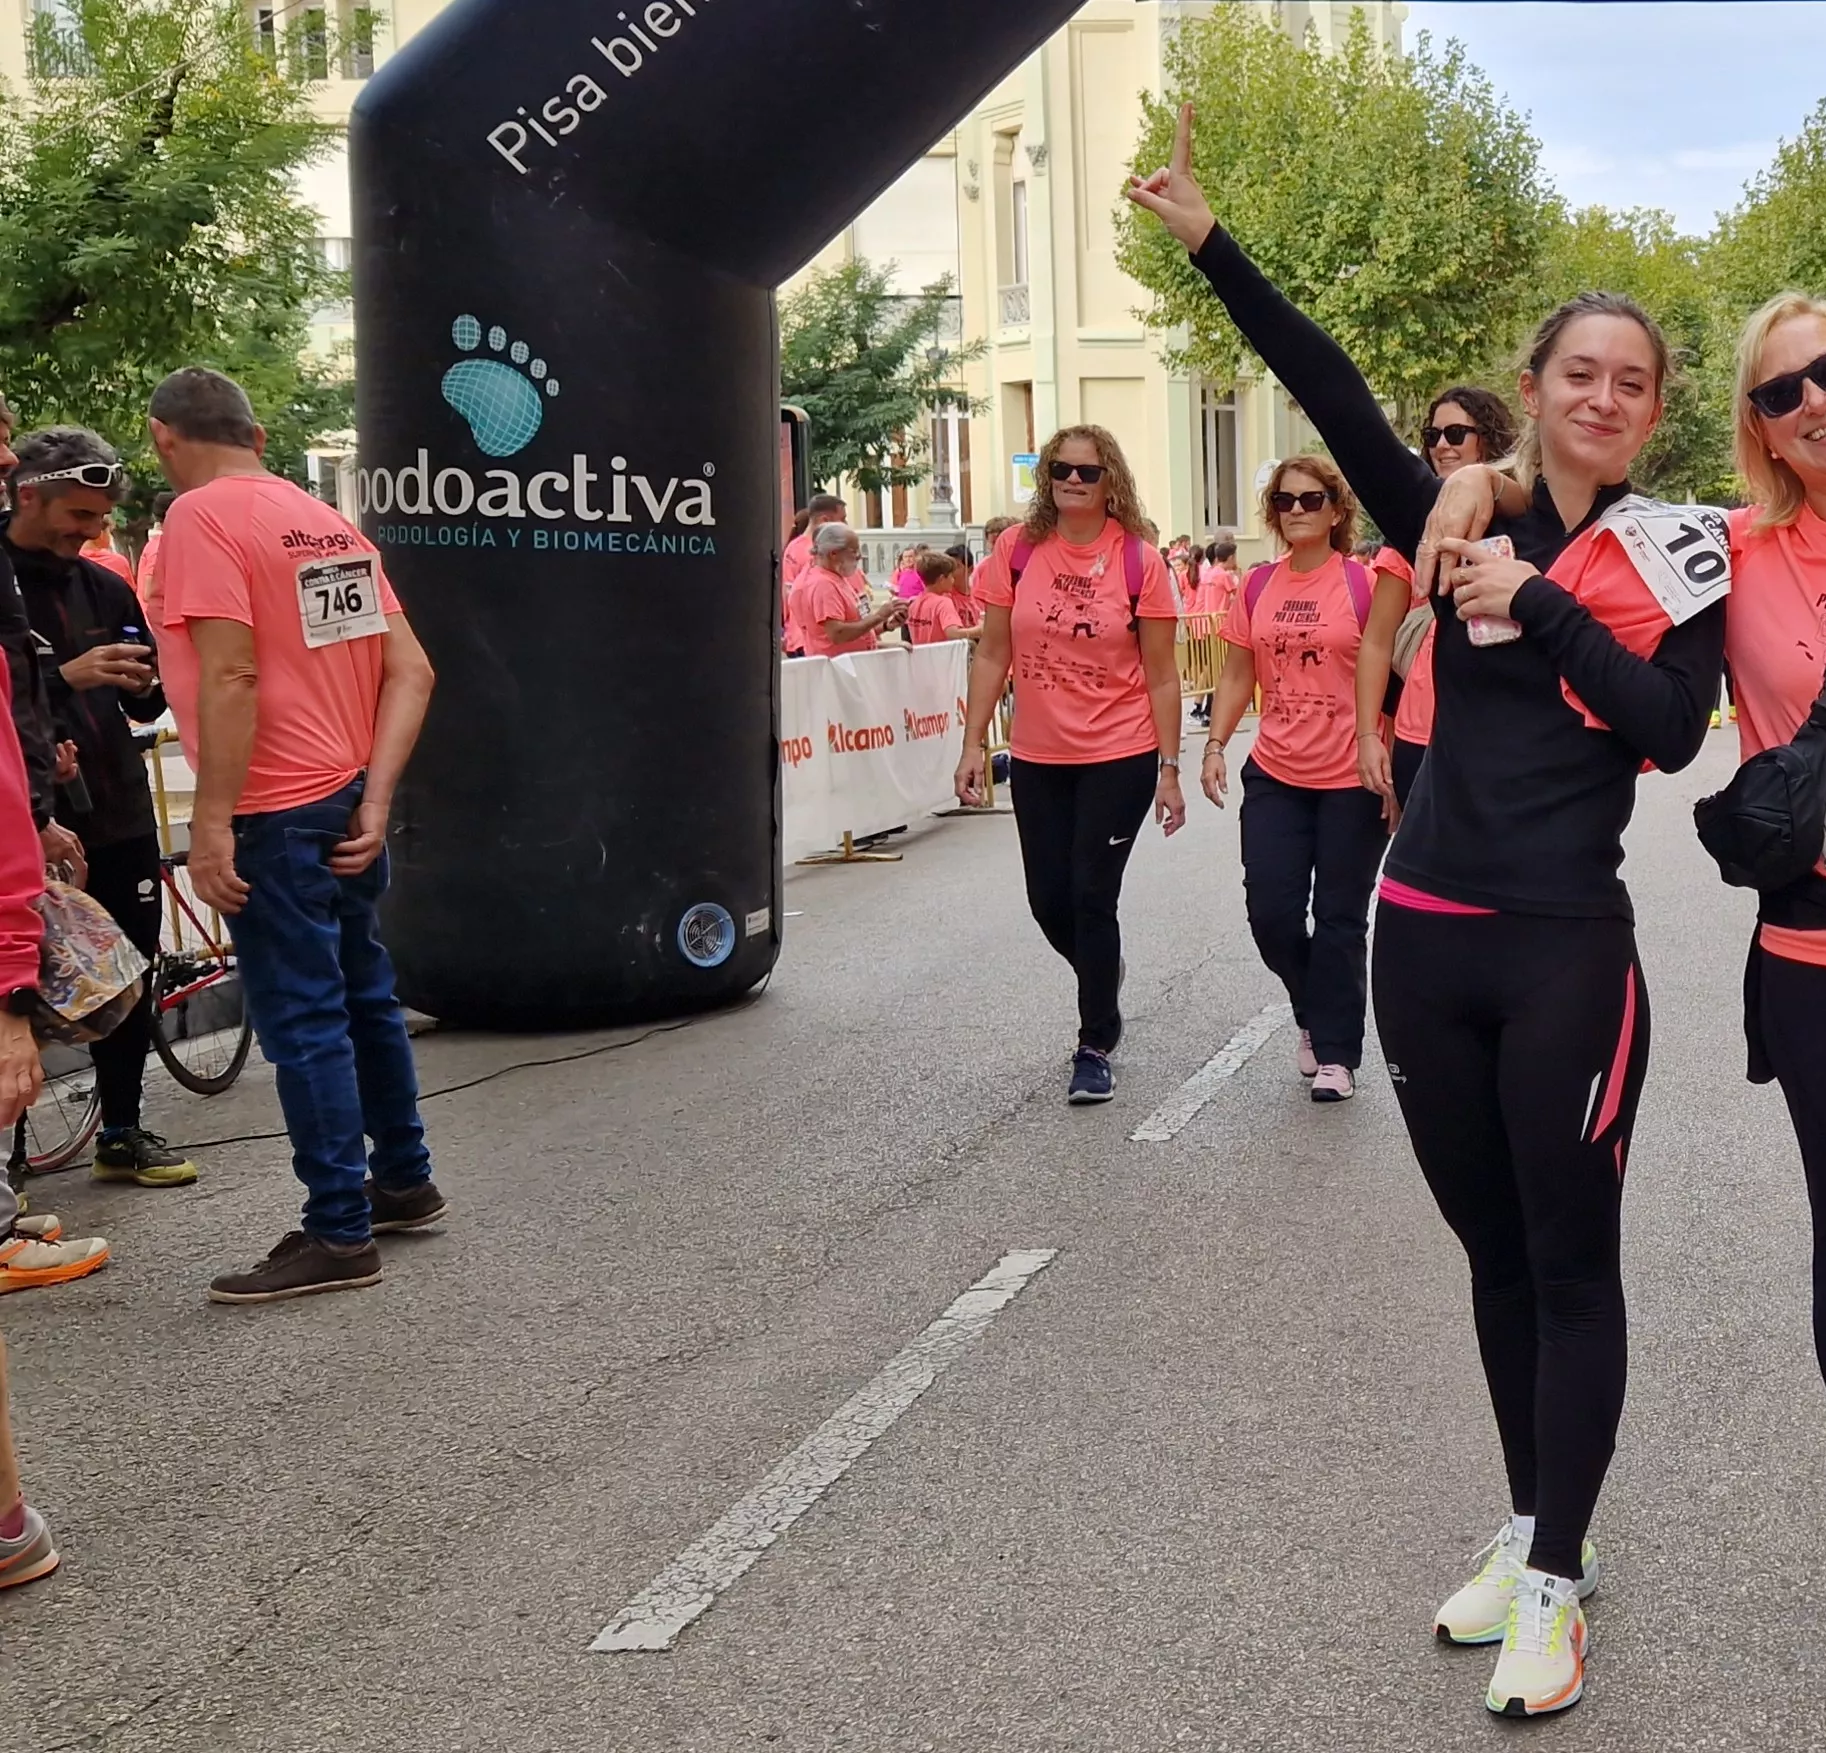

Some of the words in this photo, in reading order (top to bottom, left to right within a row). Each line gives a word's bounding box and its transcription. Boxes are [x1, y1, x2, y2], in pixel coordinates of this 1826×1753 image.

[486, 73, 609, 175] Pisa
[377, 521, 497, 548] PODOLOGÍA
[507, 528, 522, 549] Y
[532, 529, 717, 555] BIOMECÁNICA
[315, 582, 363, 620] 746
[903, 707, 950, 743] Alcampo
